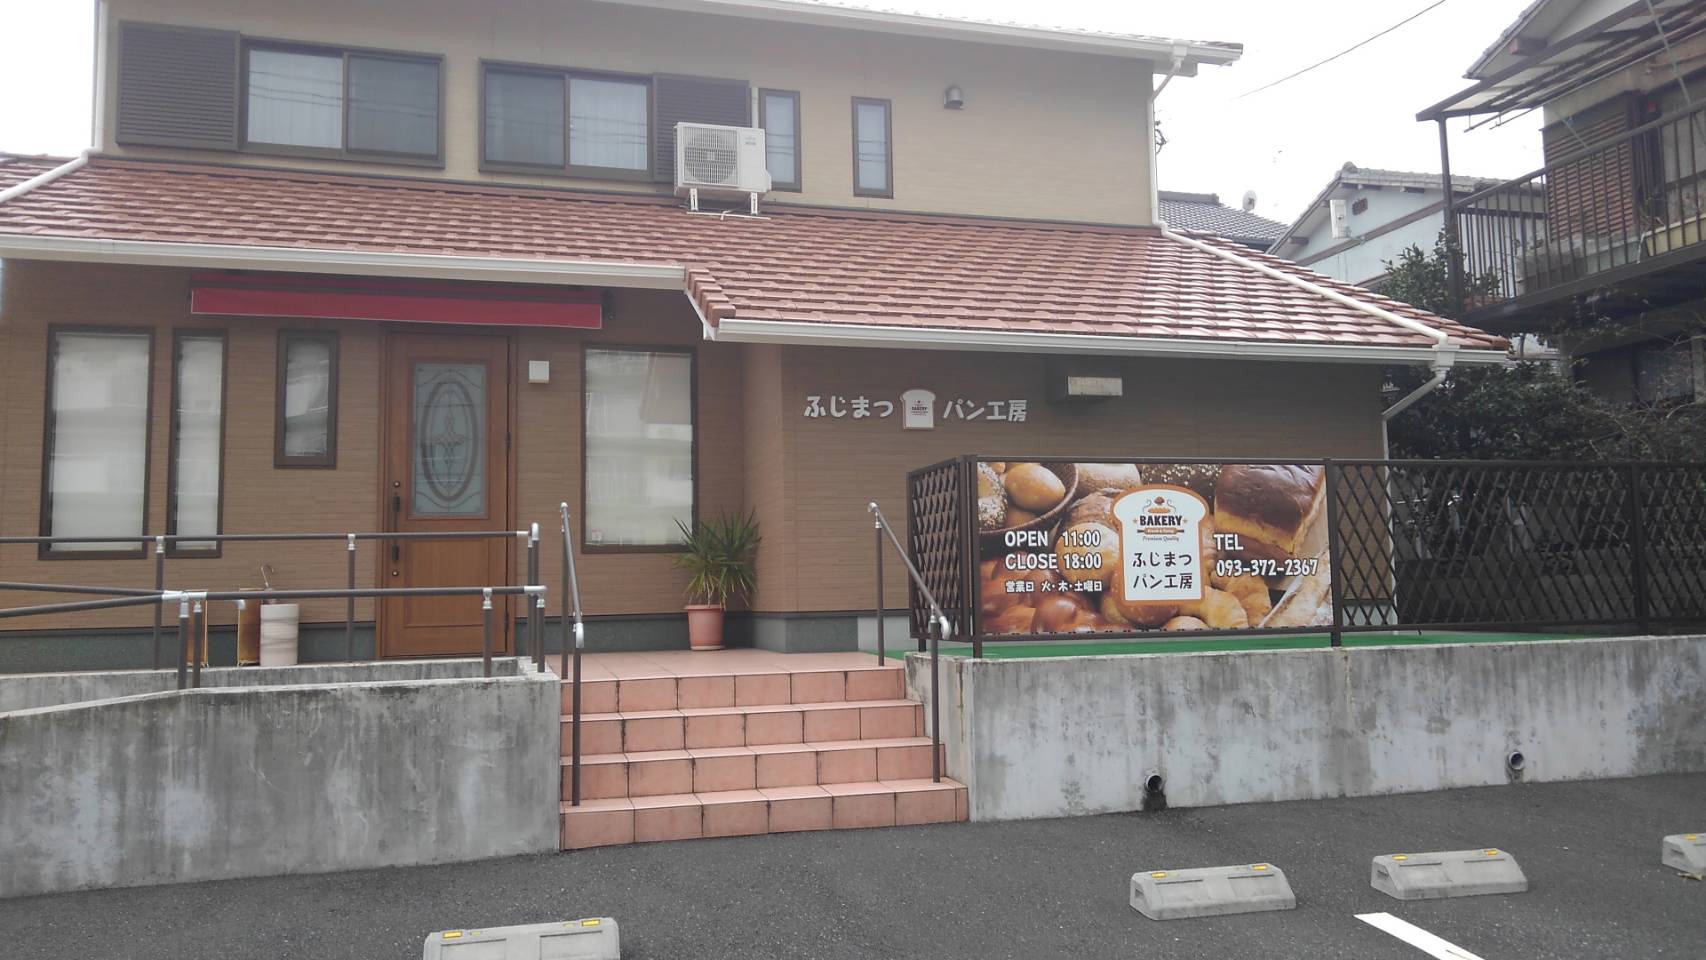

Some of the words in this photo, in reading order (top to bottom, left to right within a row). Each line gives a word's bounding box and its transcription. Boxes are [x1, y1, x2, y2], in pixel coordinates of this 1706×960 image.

[803, 395, 895, 419] ふじまつ
[943, 399, 1028, 422] パン工房
[1139, 515, 1183, 527] BAKERY
[1005, 530, 1048, 548] OPEN
[1062, 530, 1101, 547] 11:00
[1213, 533, 1244, 551] TEL
[1005, 553, 1058, 570] CLOSE
[1063, 552, 1102, 569] 18:00
[1132, 551, 1192, 568] ふじまつ
[1215, 558, 1319, 577] 093-372-2367
[1005, 580, 1034, 592] 営業日
[1132, 572, 1193, 589] パン工房
